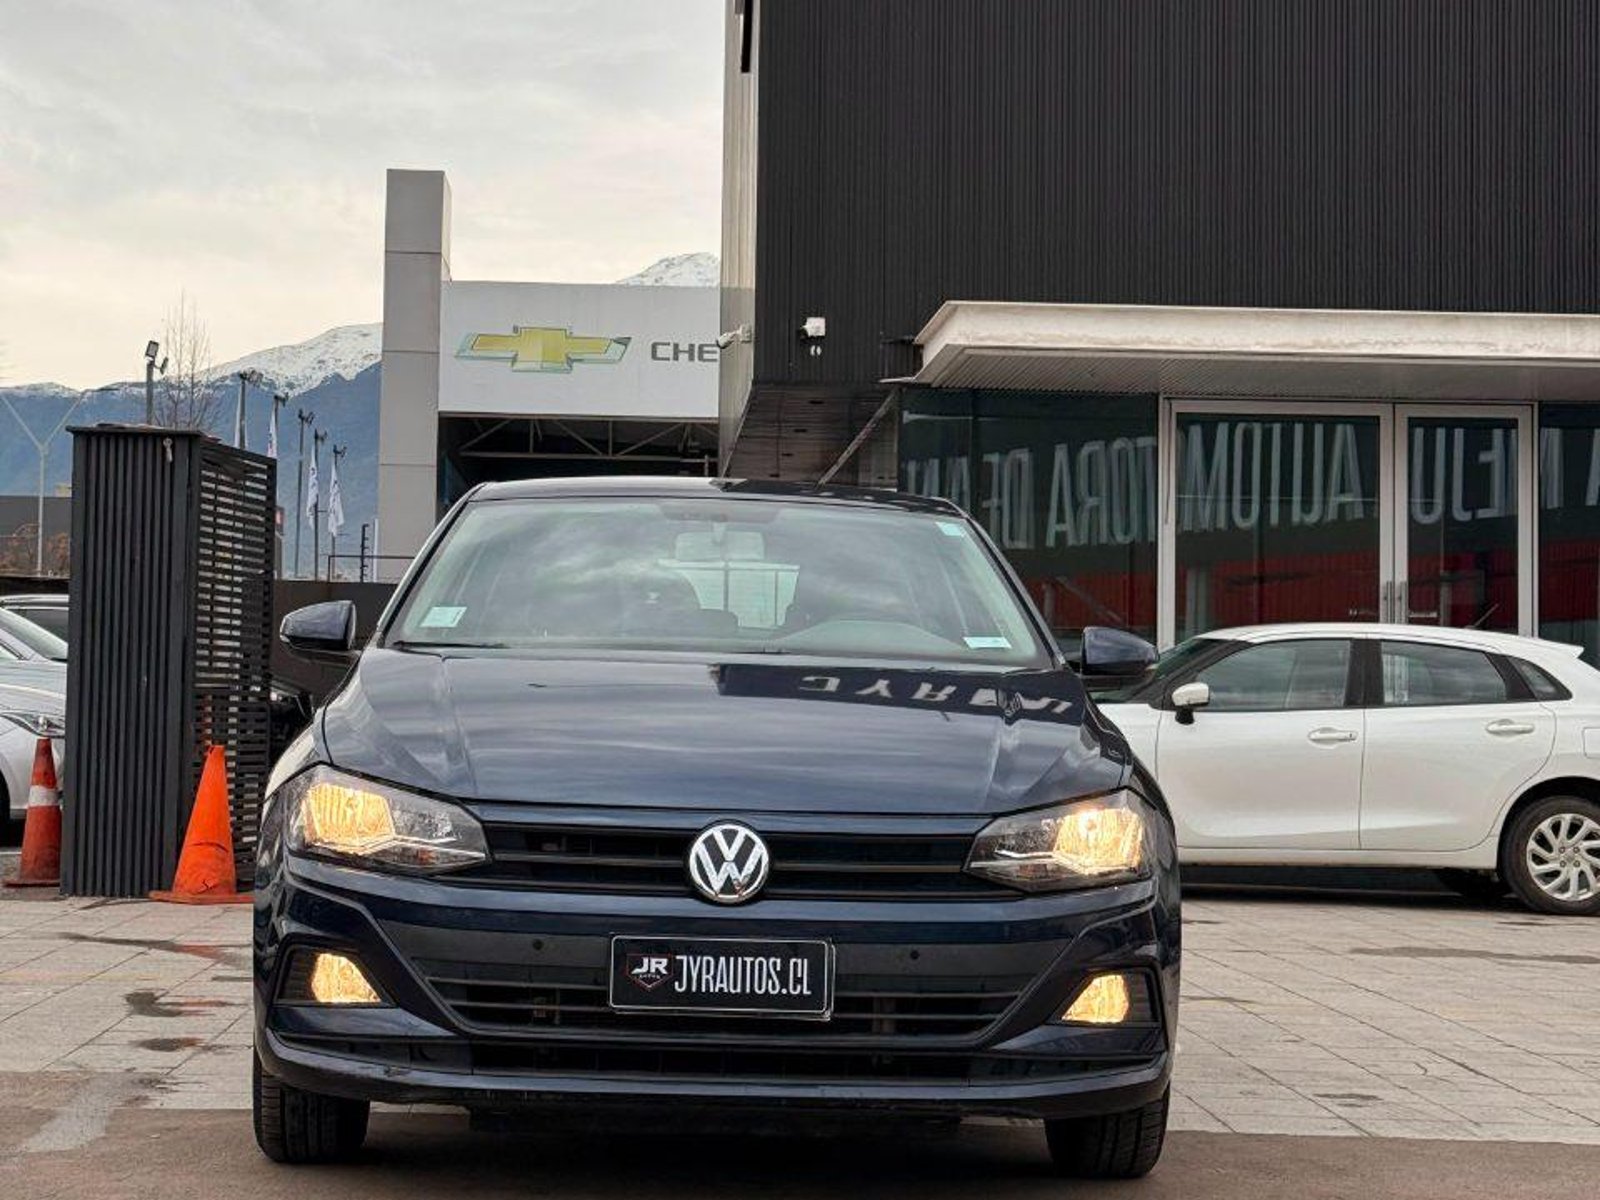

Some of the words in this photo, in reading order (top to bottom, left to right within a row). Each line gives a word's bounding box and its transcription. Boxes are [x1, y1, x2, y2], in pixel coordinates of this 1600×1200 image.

[692, 826, 767, 900] VW
[631, 957, 668, 974] JR
[675, 955, 812, 995] JYRAUTOS.CL
